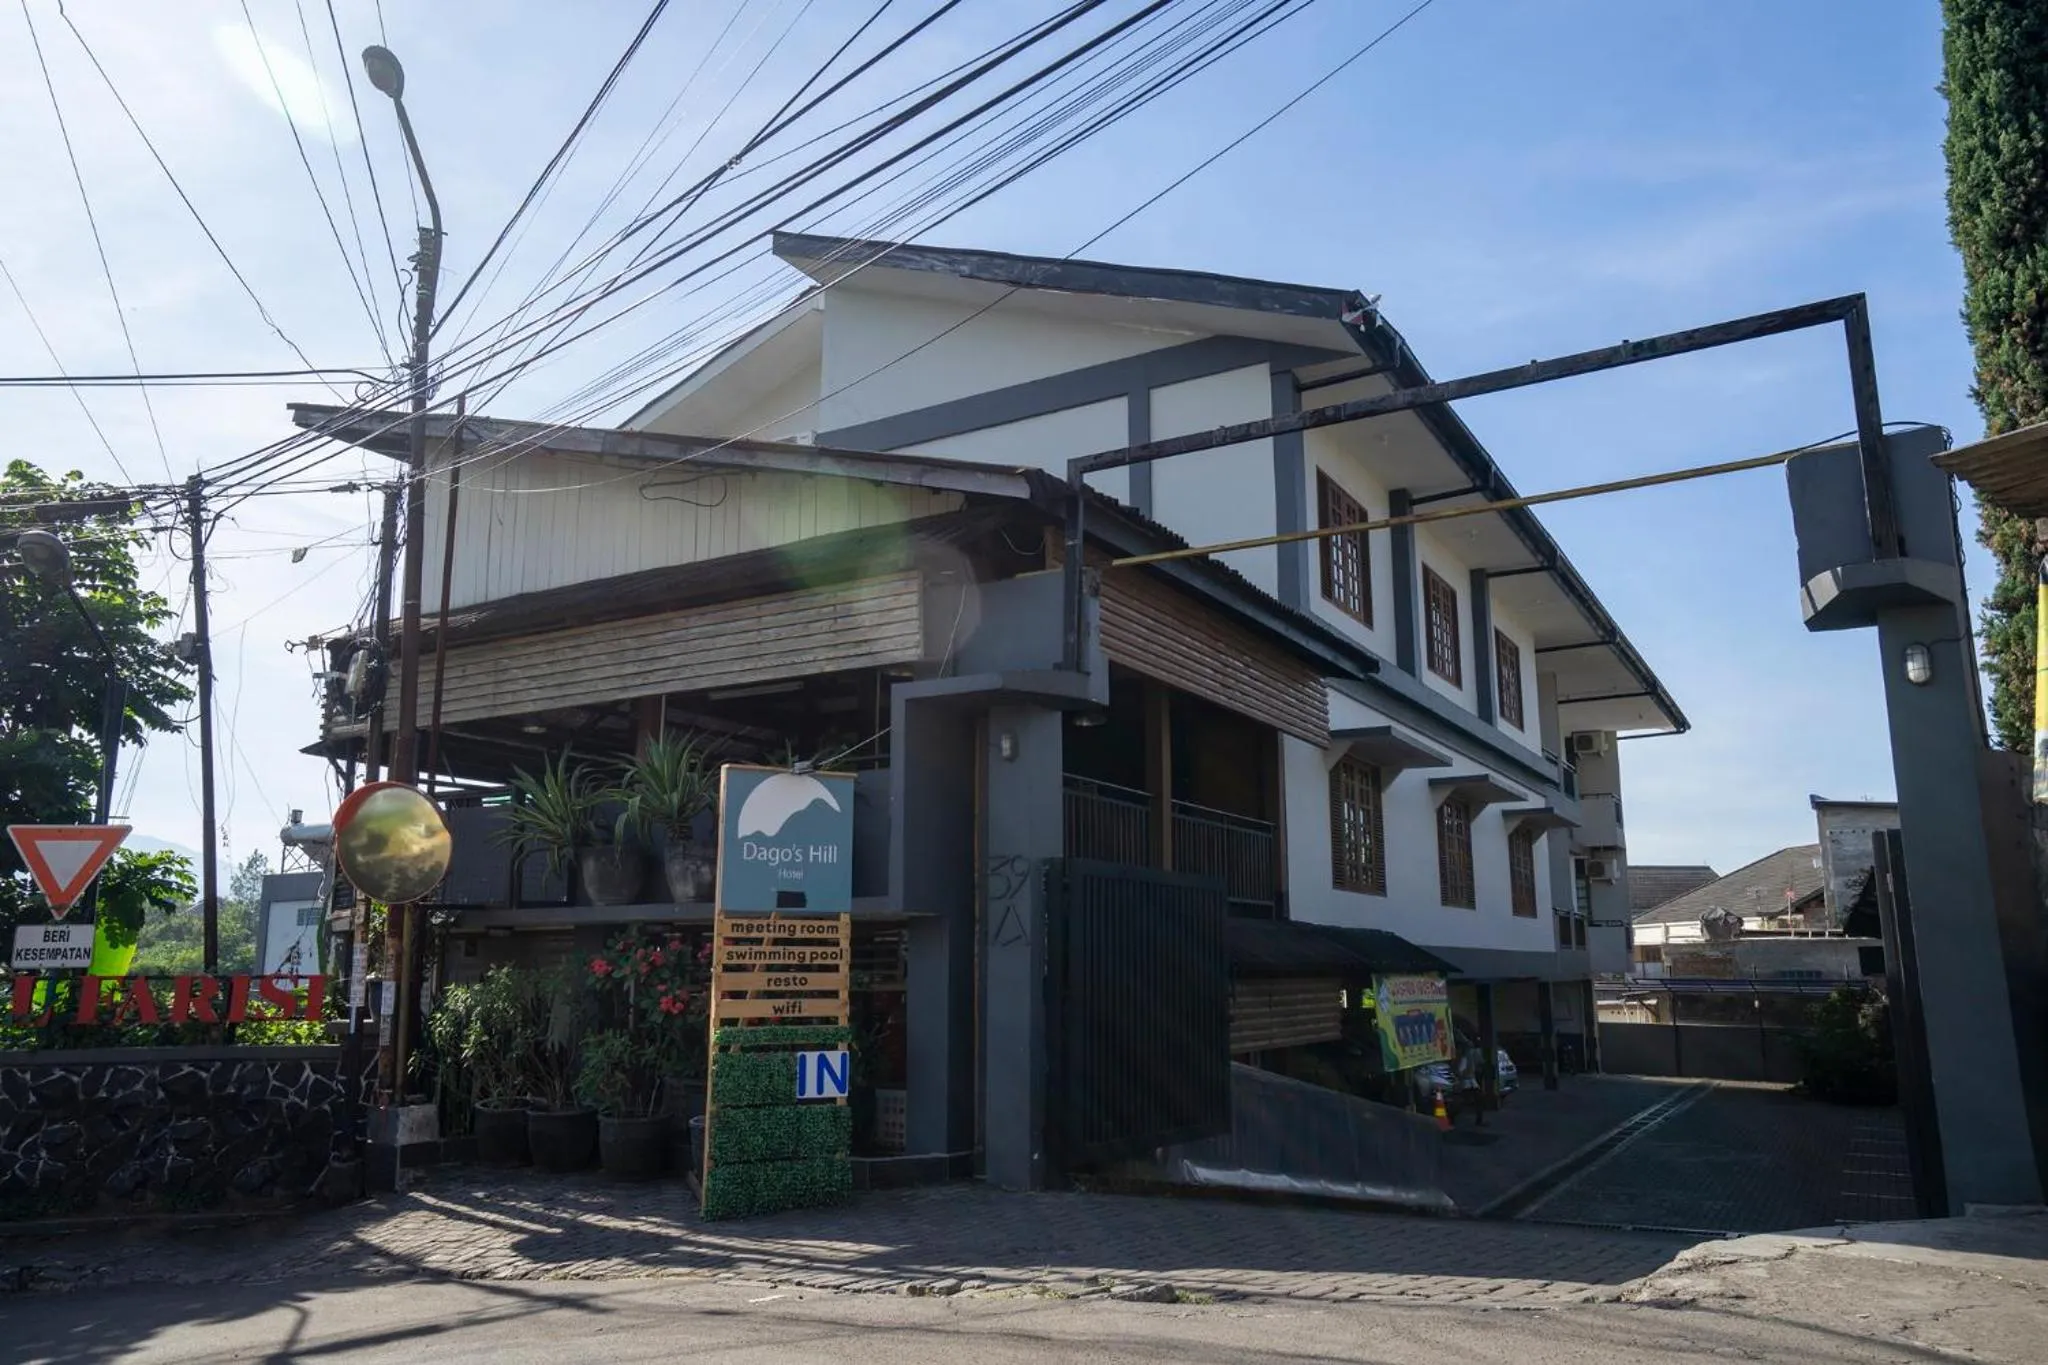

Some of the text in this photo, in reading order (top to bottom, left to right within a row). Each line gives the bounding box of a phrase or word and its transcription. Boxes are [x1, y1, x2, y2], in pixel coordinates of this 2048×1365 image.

[743, 841, 838, 866] Dago's Hill
[778, 868, 804, 880] Hotel
[43, 926, 70, 943] BERI
[731, 921, 839, 936] meeting room
[15, 948, 91, 961] KESEMPATAN
[726, 948, 843, 962] swimming pool
[767, 975, 808, 987] resto
[772, 1002, 802, 1015] wifi
[797, 1052, 848, 1096] IN
